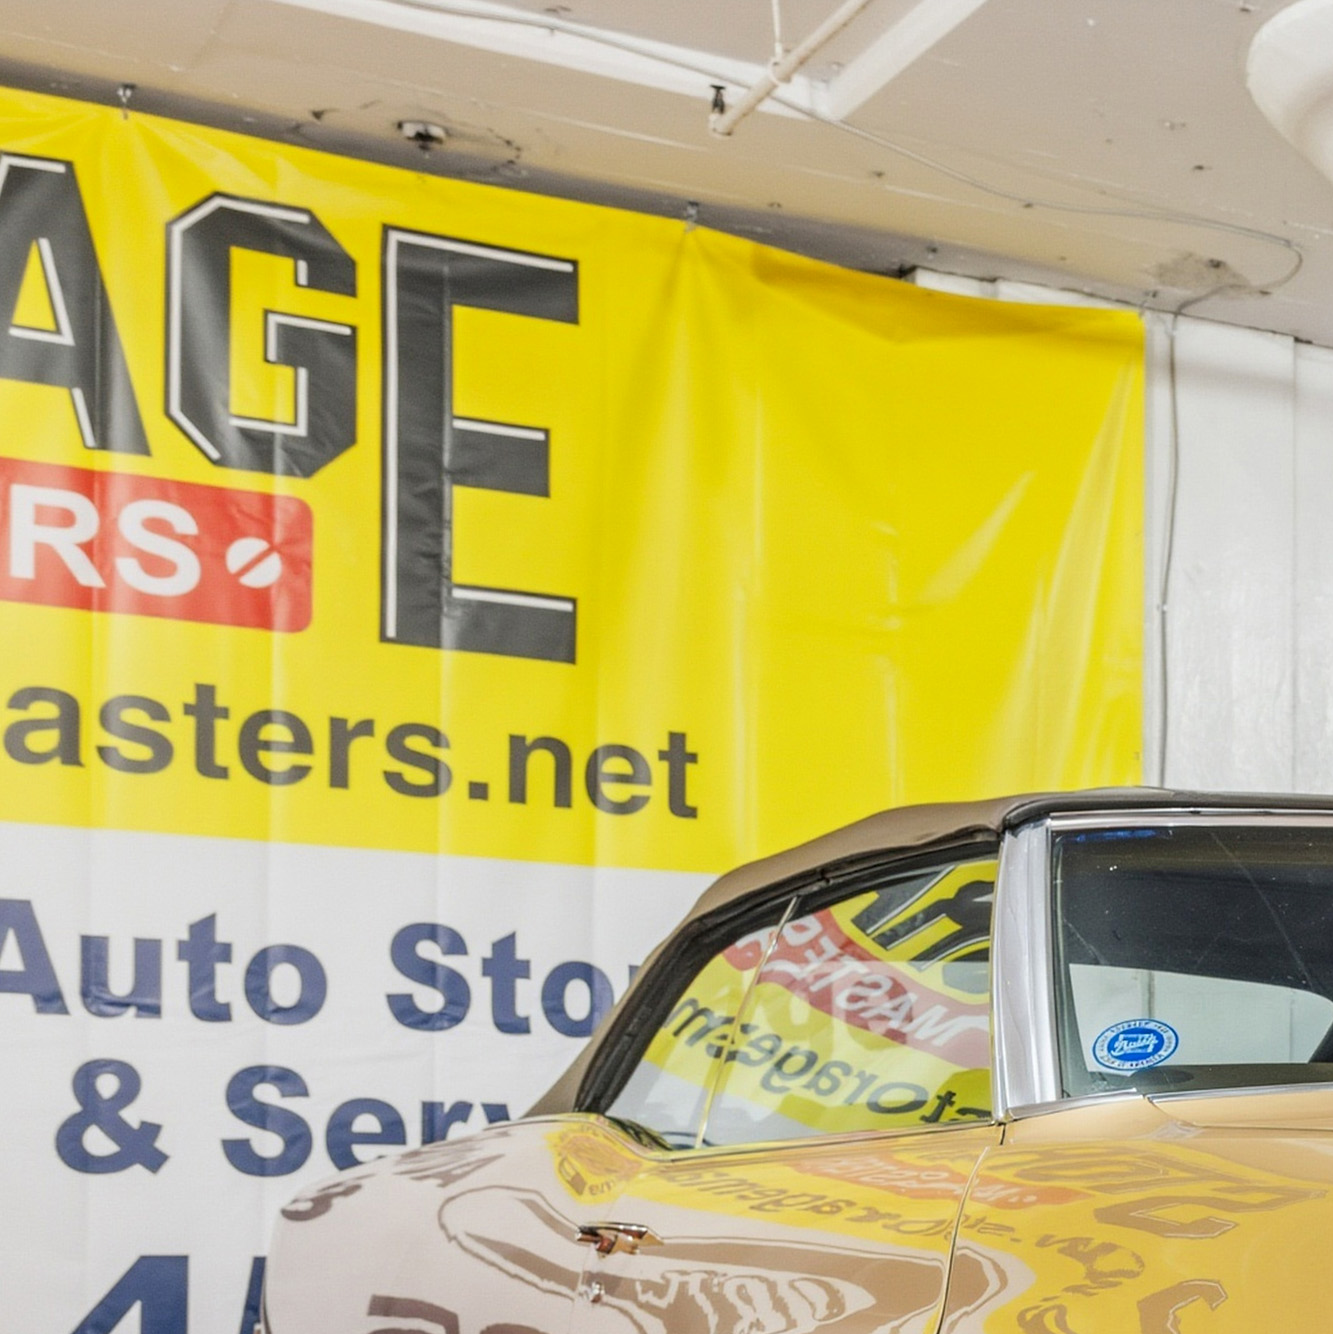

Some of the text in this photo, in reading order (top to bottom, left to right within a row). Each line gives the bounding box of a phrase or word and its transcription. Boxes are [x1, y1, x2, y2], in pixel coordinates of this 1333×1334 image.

[9, 483, 202, 597] RS
[2, 683, 699, 820] asters.net
[0, 898, 641, 1039] Auto Sto
[55, 1059, 511, 1178] & Ser
